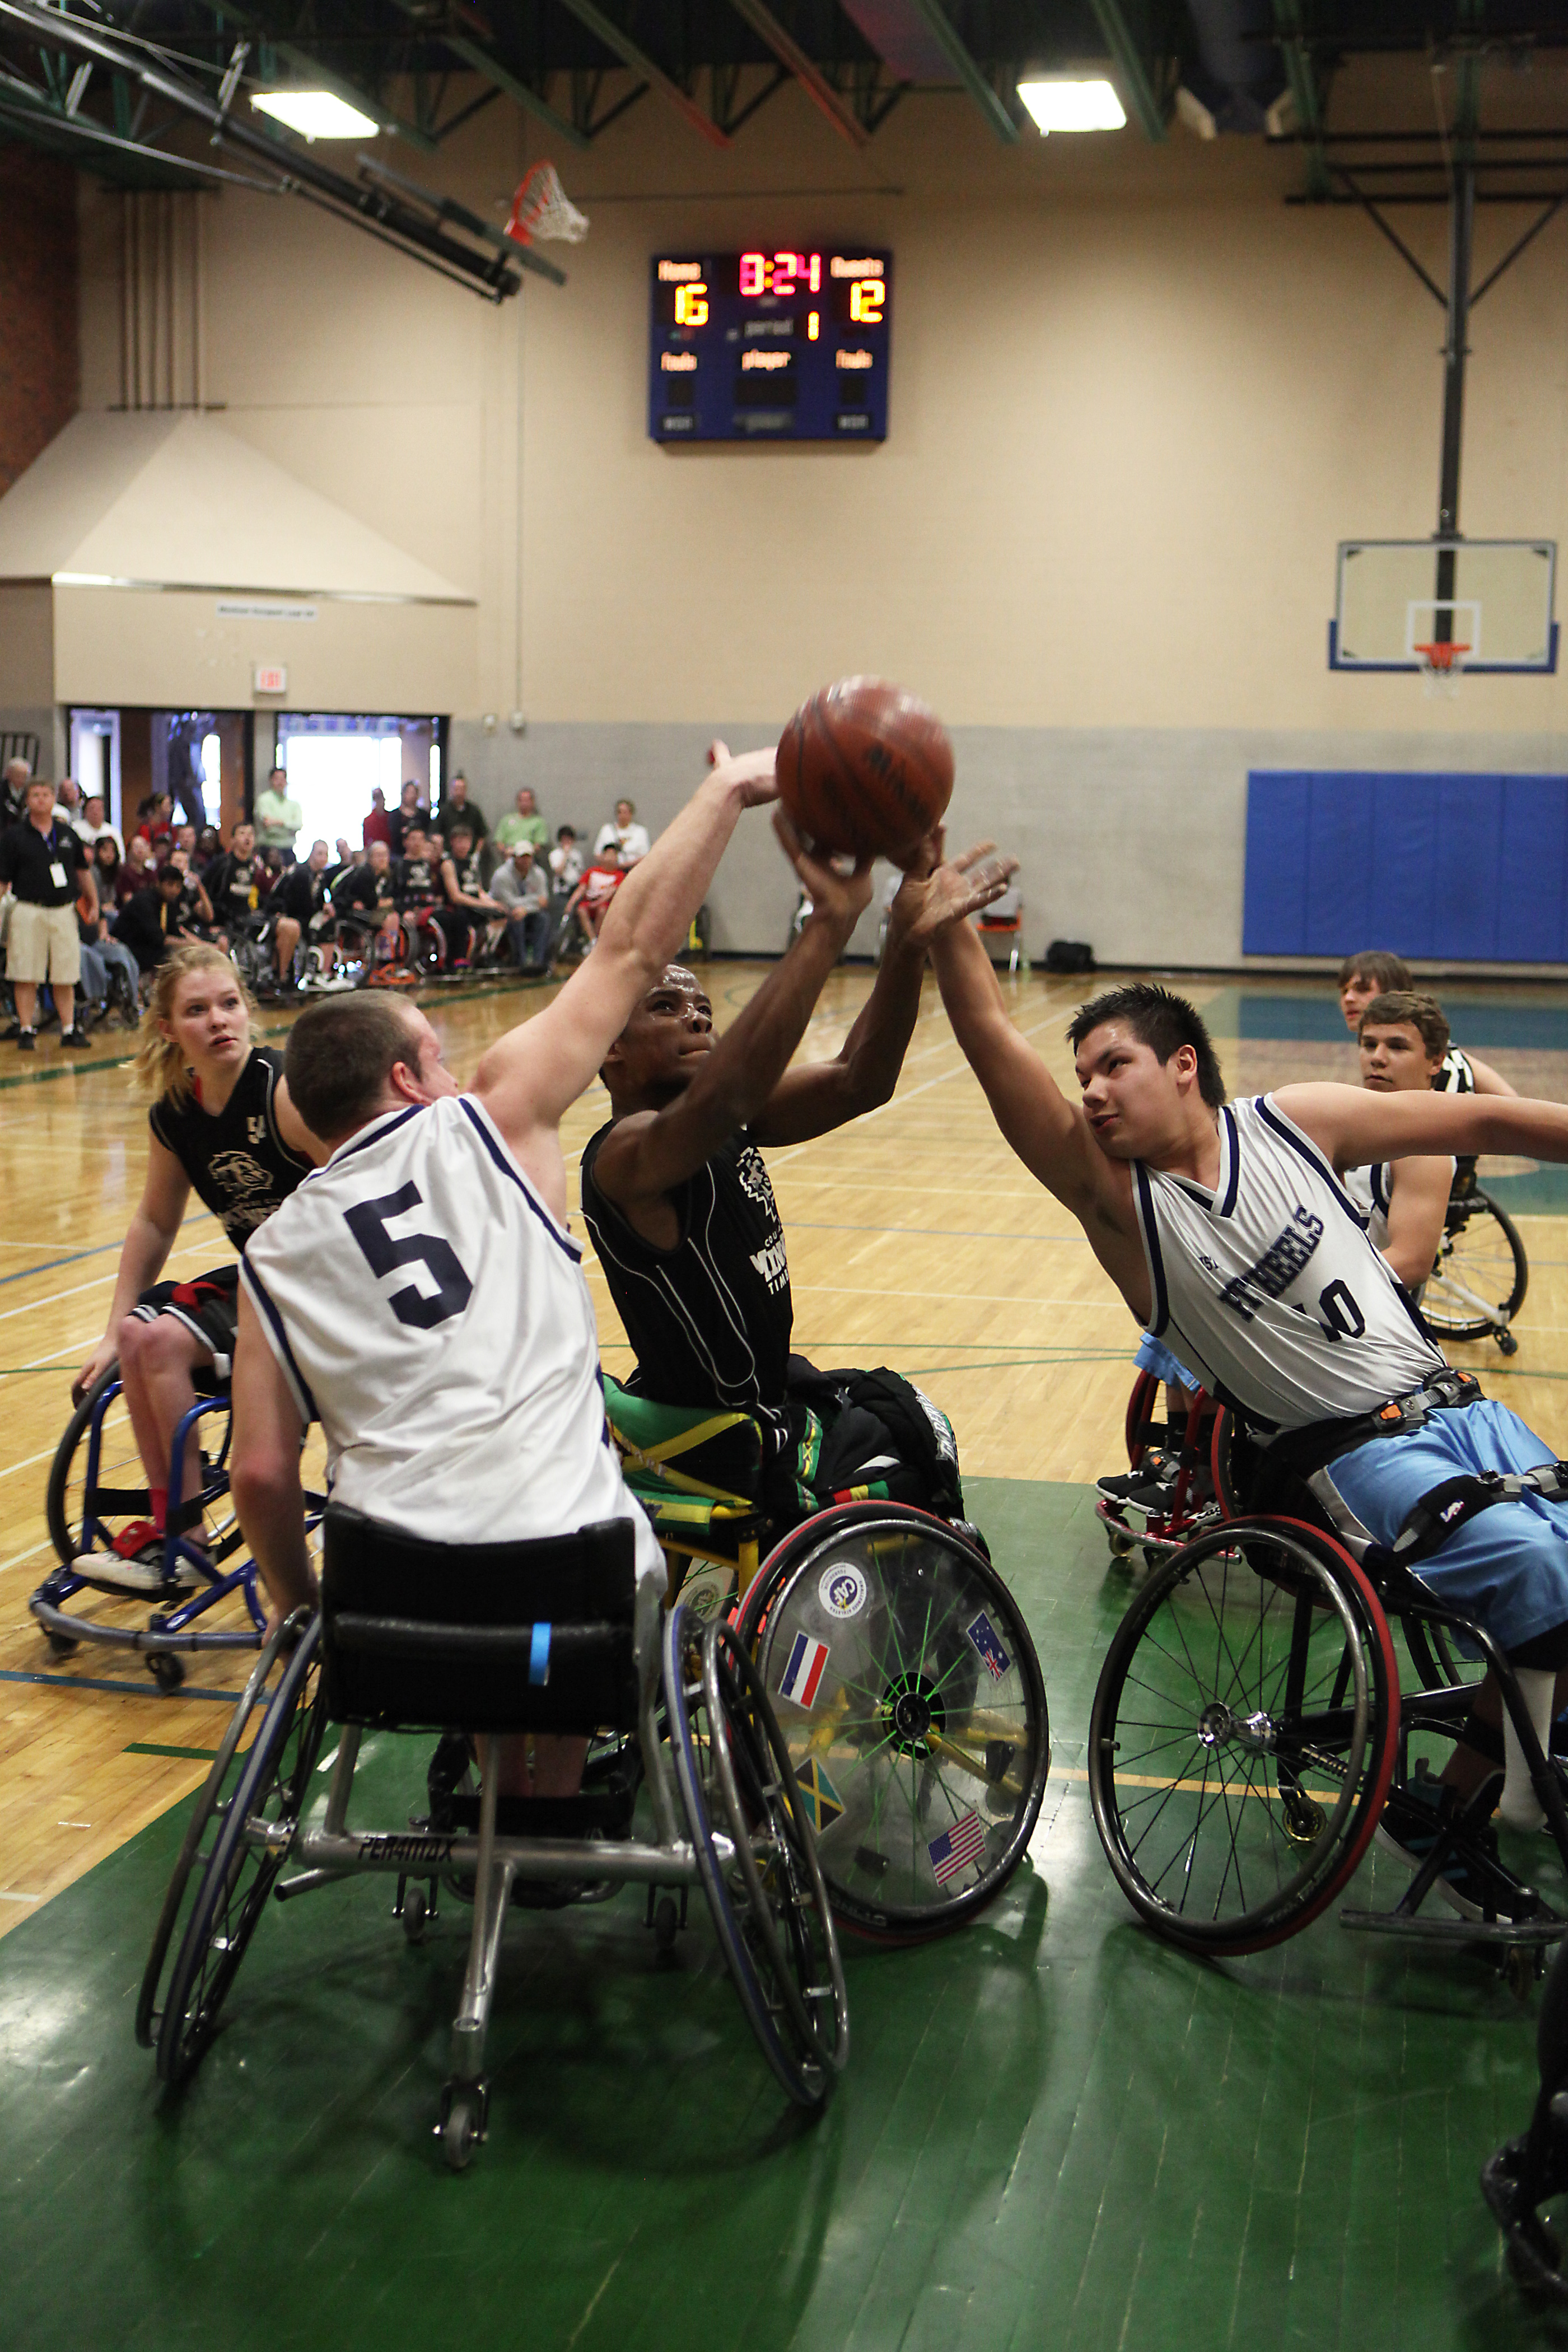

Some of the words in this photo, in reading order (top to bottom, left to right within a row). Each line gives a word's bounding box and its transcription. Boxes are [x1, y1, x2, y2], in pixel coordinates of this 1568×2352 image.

[739, 252, 821, 296] 8:24
[675, 283, 708, 326] 16
[850, 279, 885, 323] 12
[808, 311, 819, 341] 1
[342, 1180, 473, 1329] 5
